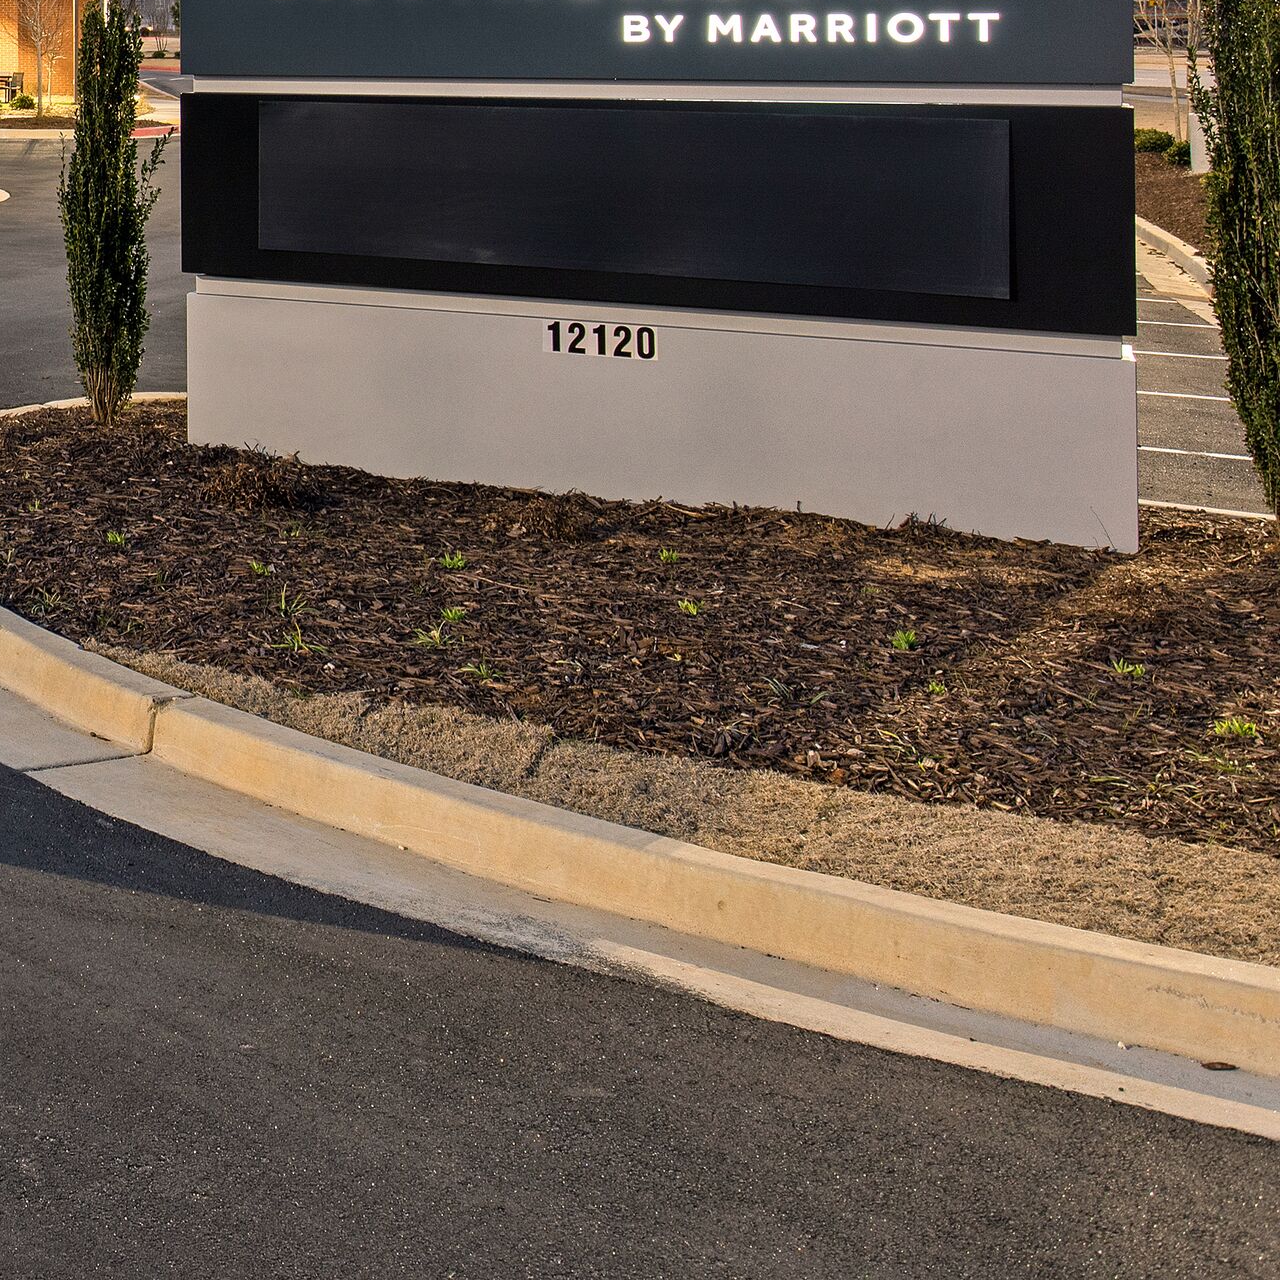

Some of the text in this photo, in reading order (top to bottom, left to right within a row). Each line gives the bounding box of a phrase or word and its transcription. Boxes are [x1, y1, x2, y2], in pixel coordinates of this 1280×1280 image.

[622, 12, 1001, 43] BY MARRIOTT
[547, 321, 656, 359] 12120
